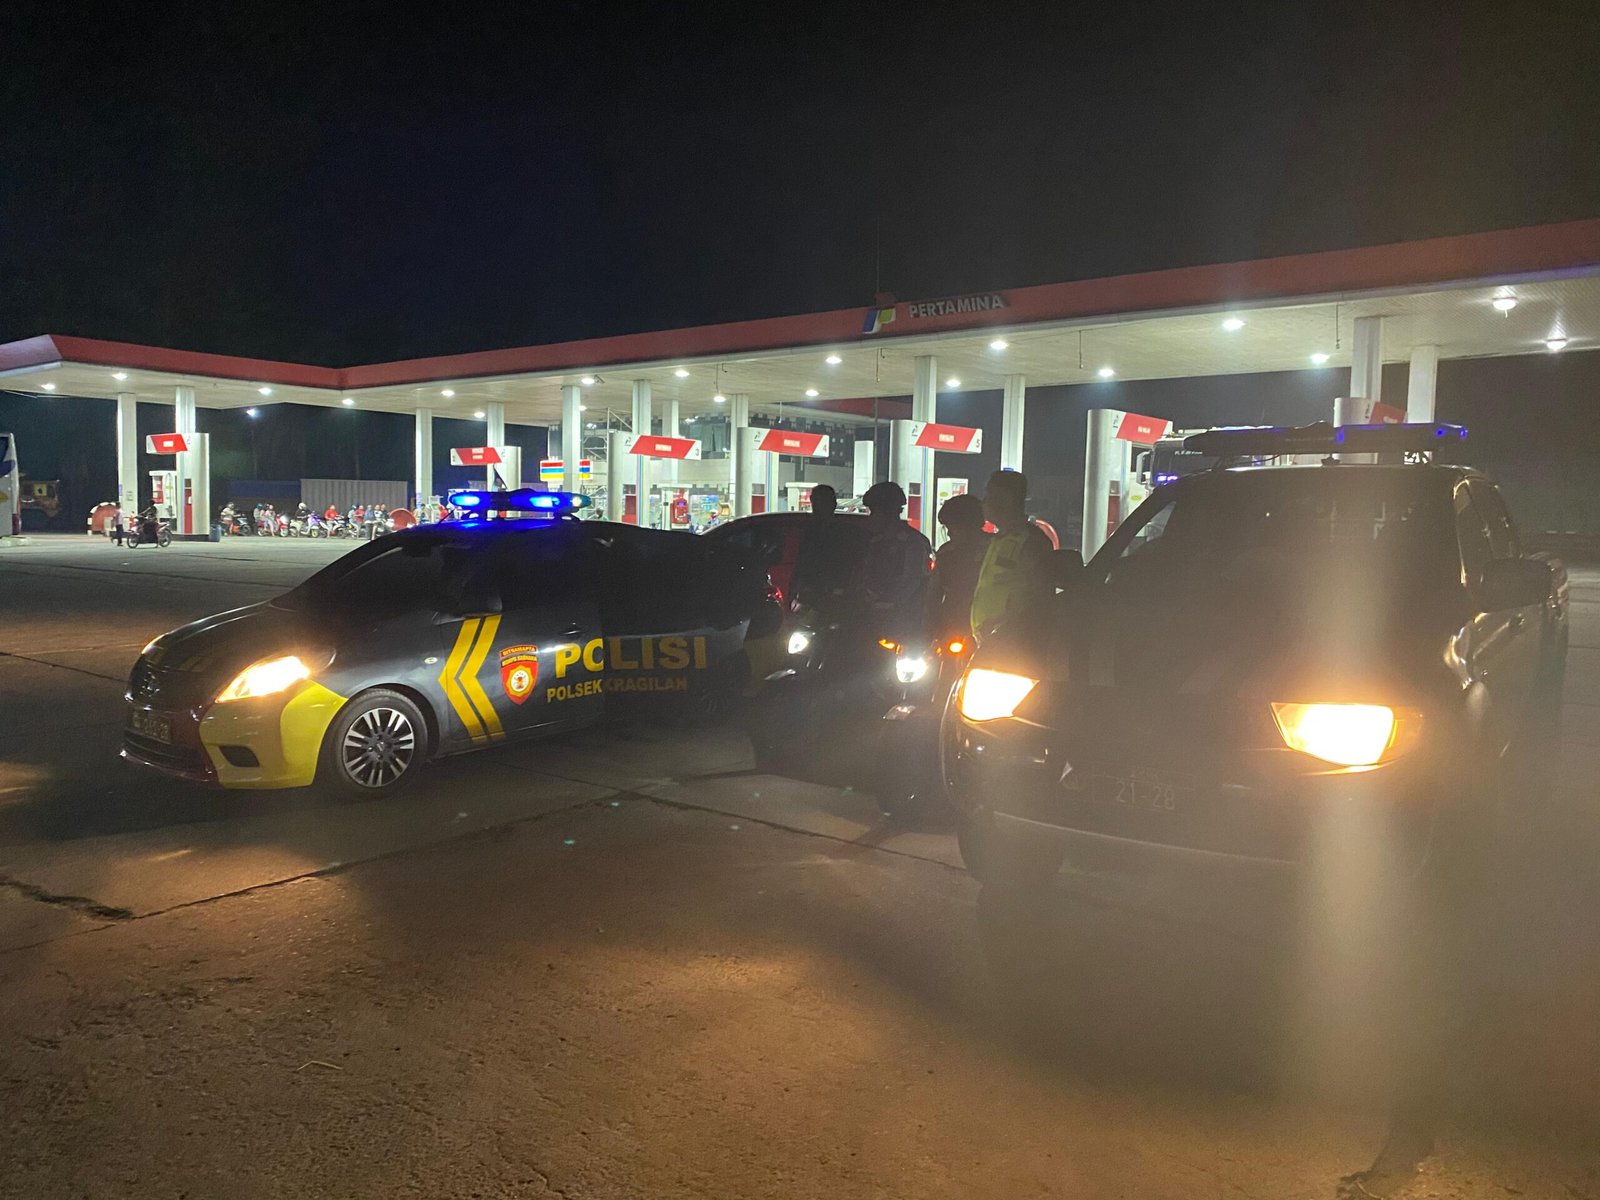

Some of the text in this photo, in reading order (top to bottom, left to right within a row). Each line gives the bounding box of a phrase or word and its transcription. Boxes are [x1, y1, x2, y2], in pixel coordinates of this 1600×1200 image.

[908, 294, 1004, 319] PERTAMINA
[554, 635, 707, 679] POLISI
[546, 678, 603, 704] POLSEK
